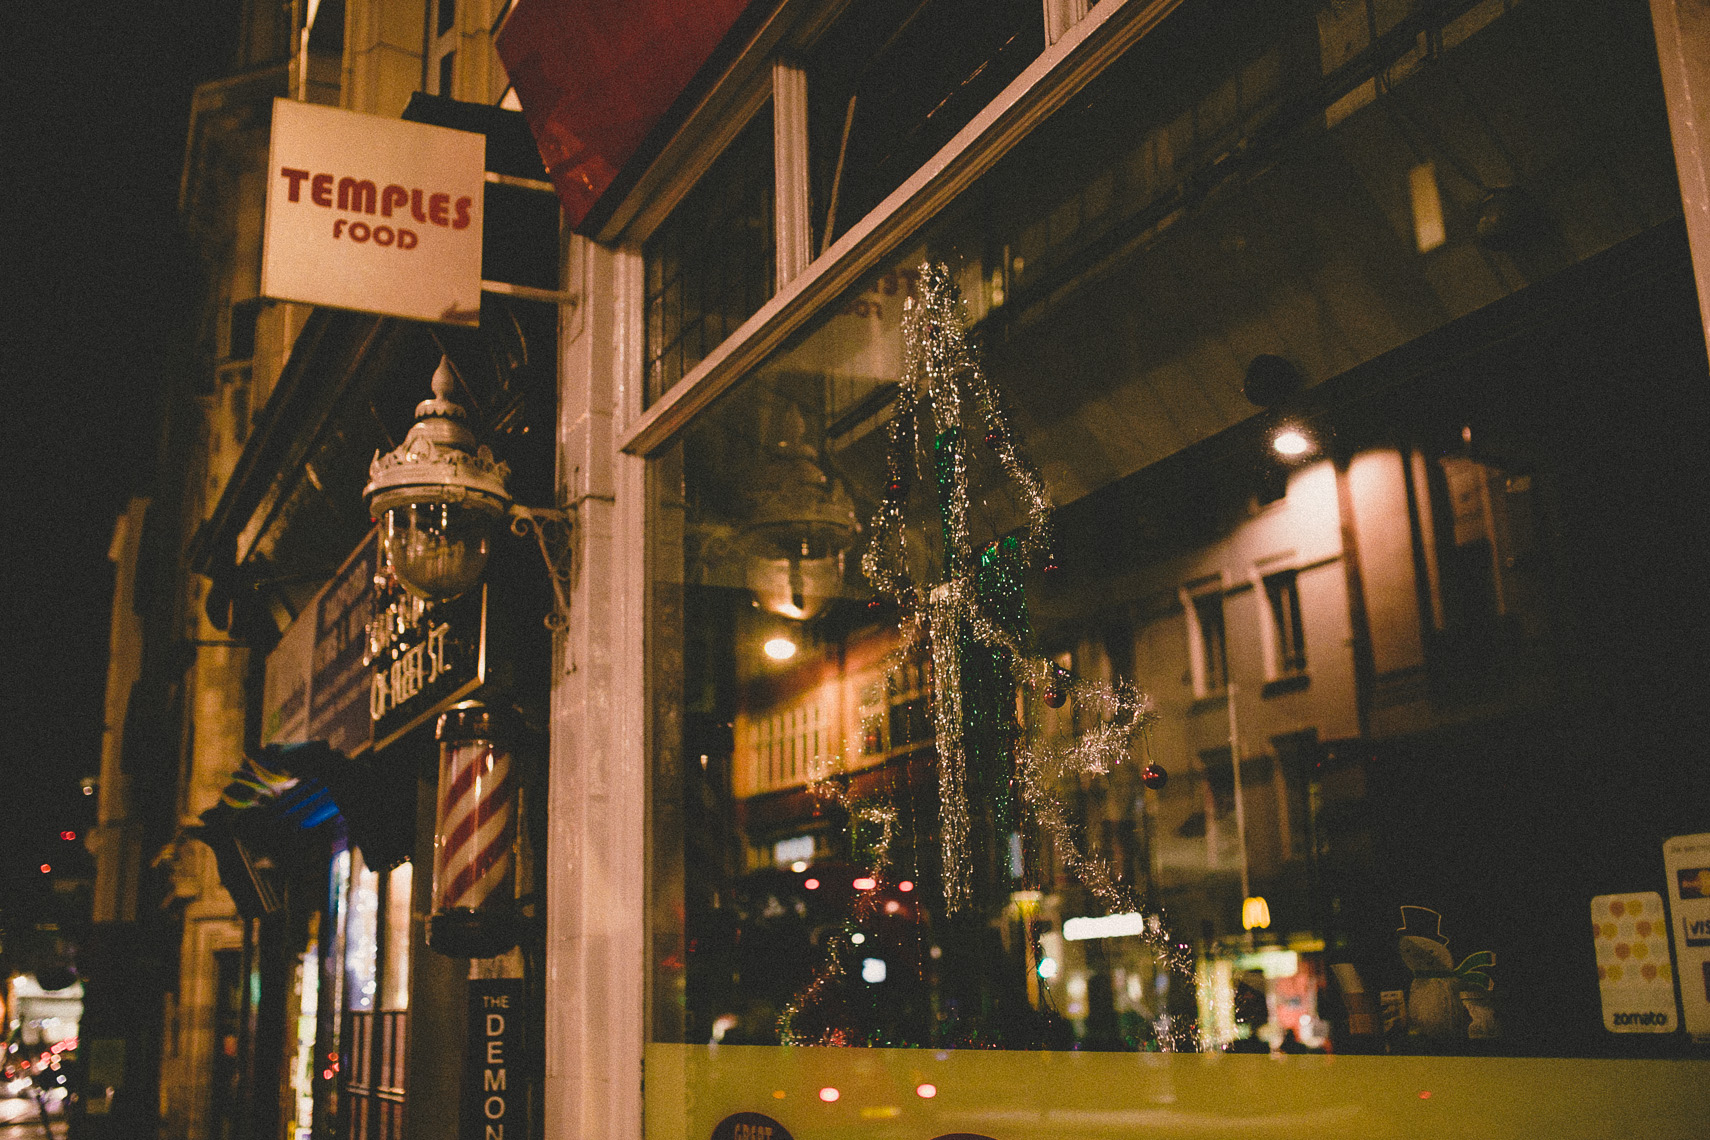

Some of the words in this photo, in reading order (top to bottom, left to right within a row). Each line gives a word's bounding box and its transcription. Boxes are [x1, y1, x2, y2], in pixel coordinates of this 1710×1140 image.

[281, 167, 472, 230] TEMPLES
[333, 218, 418, 250] FOOD
[482, 995, 510, 1009] THE
[1613, 1012, 1668, 1026] zomato
[483, 1013, 507, 1140] DEMON
